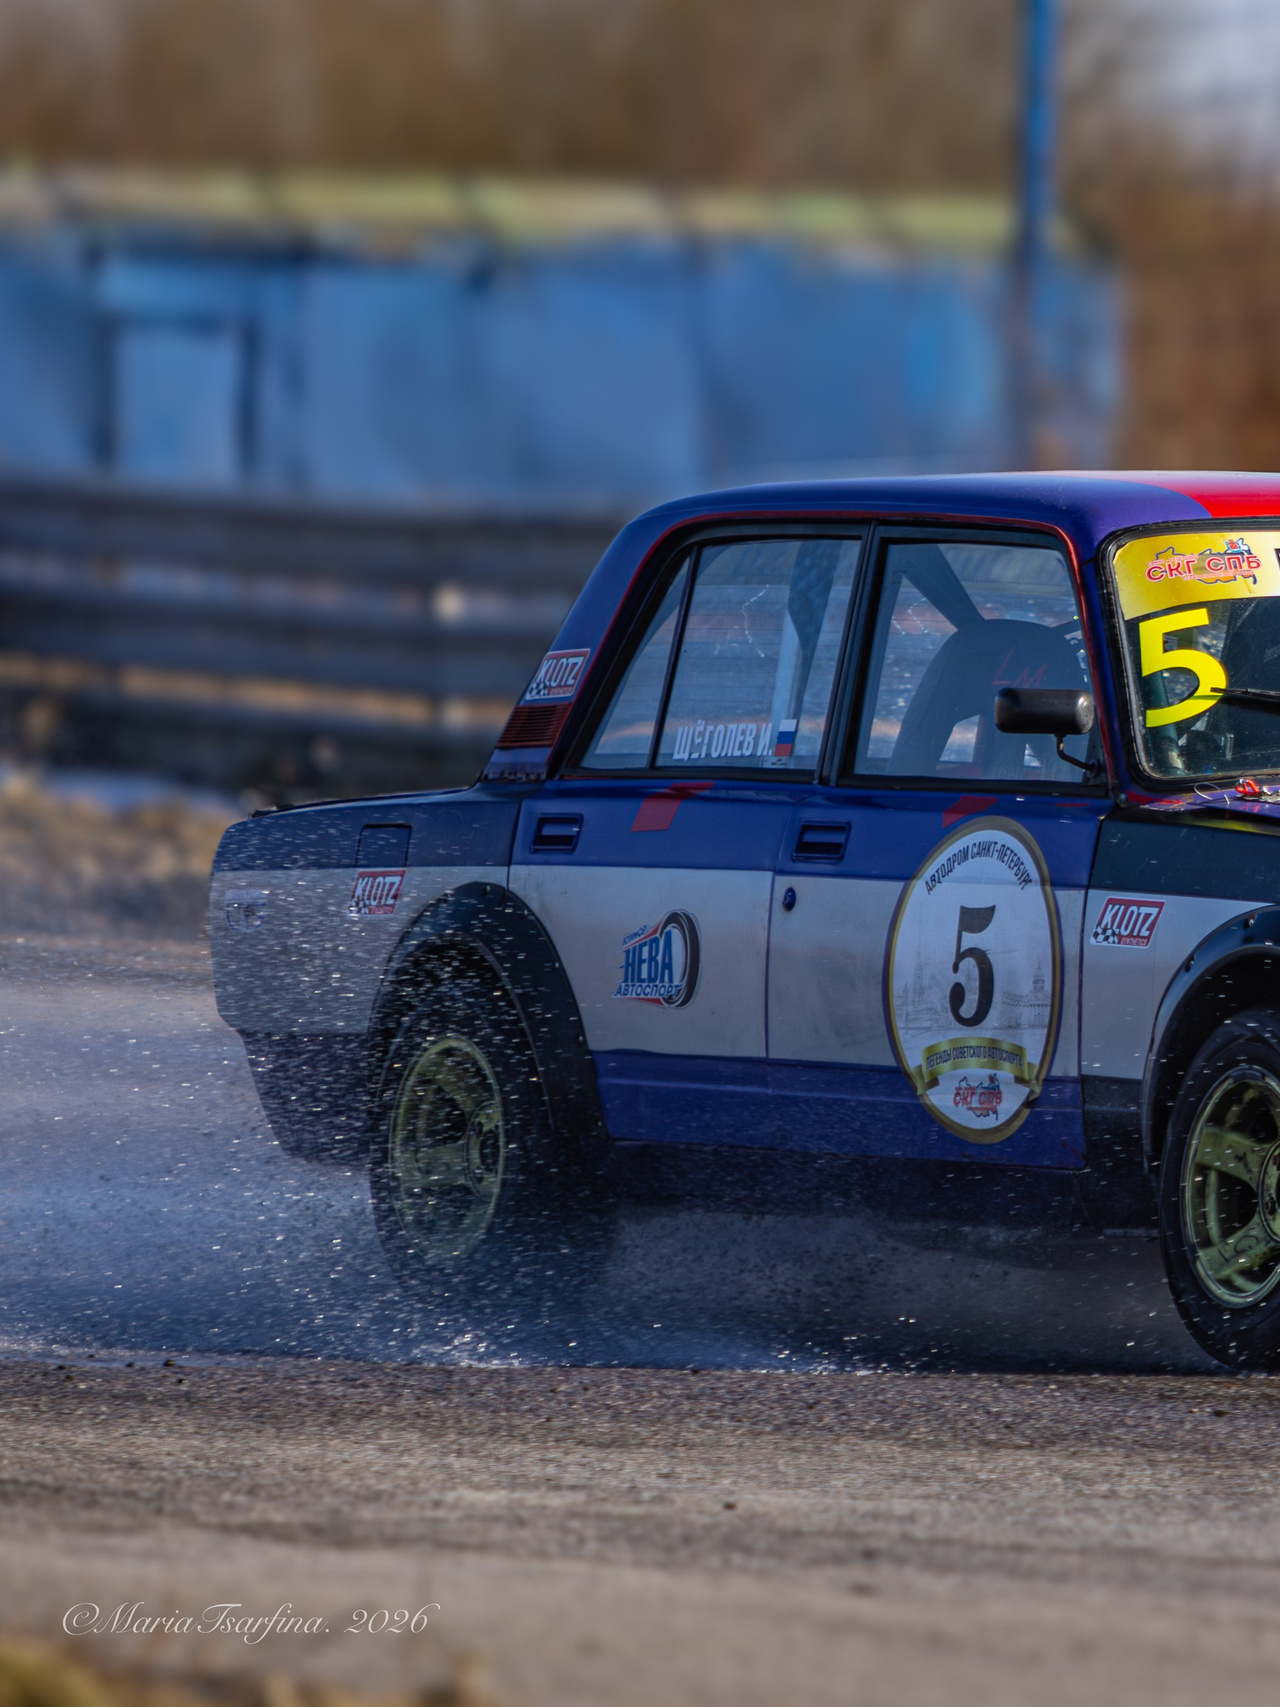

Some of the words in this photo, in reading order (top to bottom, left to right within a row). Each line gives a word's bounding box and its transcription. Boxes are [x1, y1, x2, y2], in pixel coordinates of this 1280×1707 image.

[1145, 559, 1197, 582] СКГ
[1205, 554, 1262, 572] СПБ
[536, 656, 584, 687] KLOTZ
[1138, 607, 1229, 728] 5
[672, 720, 757, 761] ЩЁГОЛЕВ
[924, 845, 970, 895] АВТОДРОМ
[970, 841, 1032, 890] САНКТ-ПЕТЕРБУРГ
[354, 875, 402, 906] KLOTZ
[1100, 904, 1160, 937] KLOTZ
[621, 929, 674, 984] НЕВА
[949, 904, 996, 1028] 5
[614, 983, 683, 998] АВТОСПОРТ
